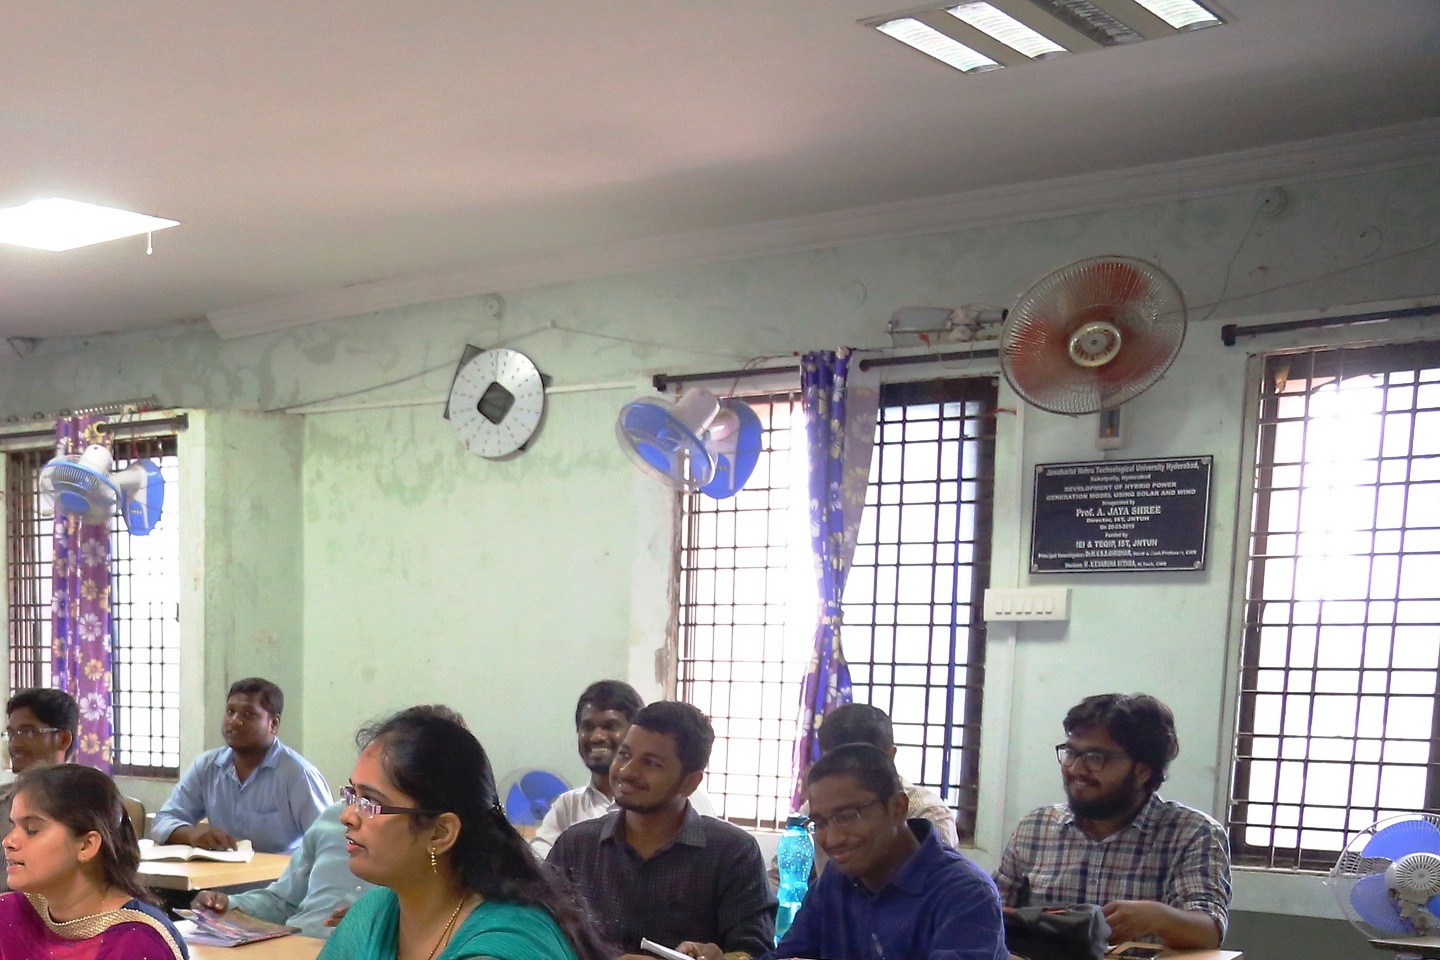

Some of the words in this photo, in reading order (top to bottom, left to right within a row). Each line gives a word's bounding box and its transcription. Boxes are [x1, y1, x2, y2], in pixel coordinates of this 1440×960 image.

[1136, 463, 1164, 472] University
[1076, 508, 1095, 517] Prof.
[1097, 508, 1105, 516] A.
[1107, 507, 1129, 516] JAYA
[1131, 505, 1161, 515] SHREE
